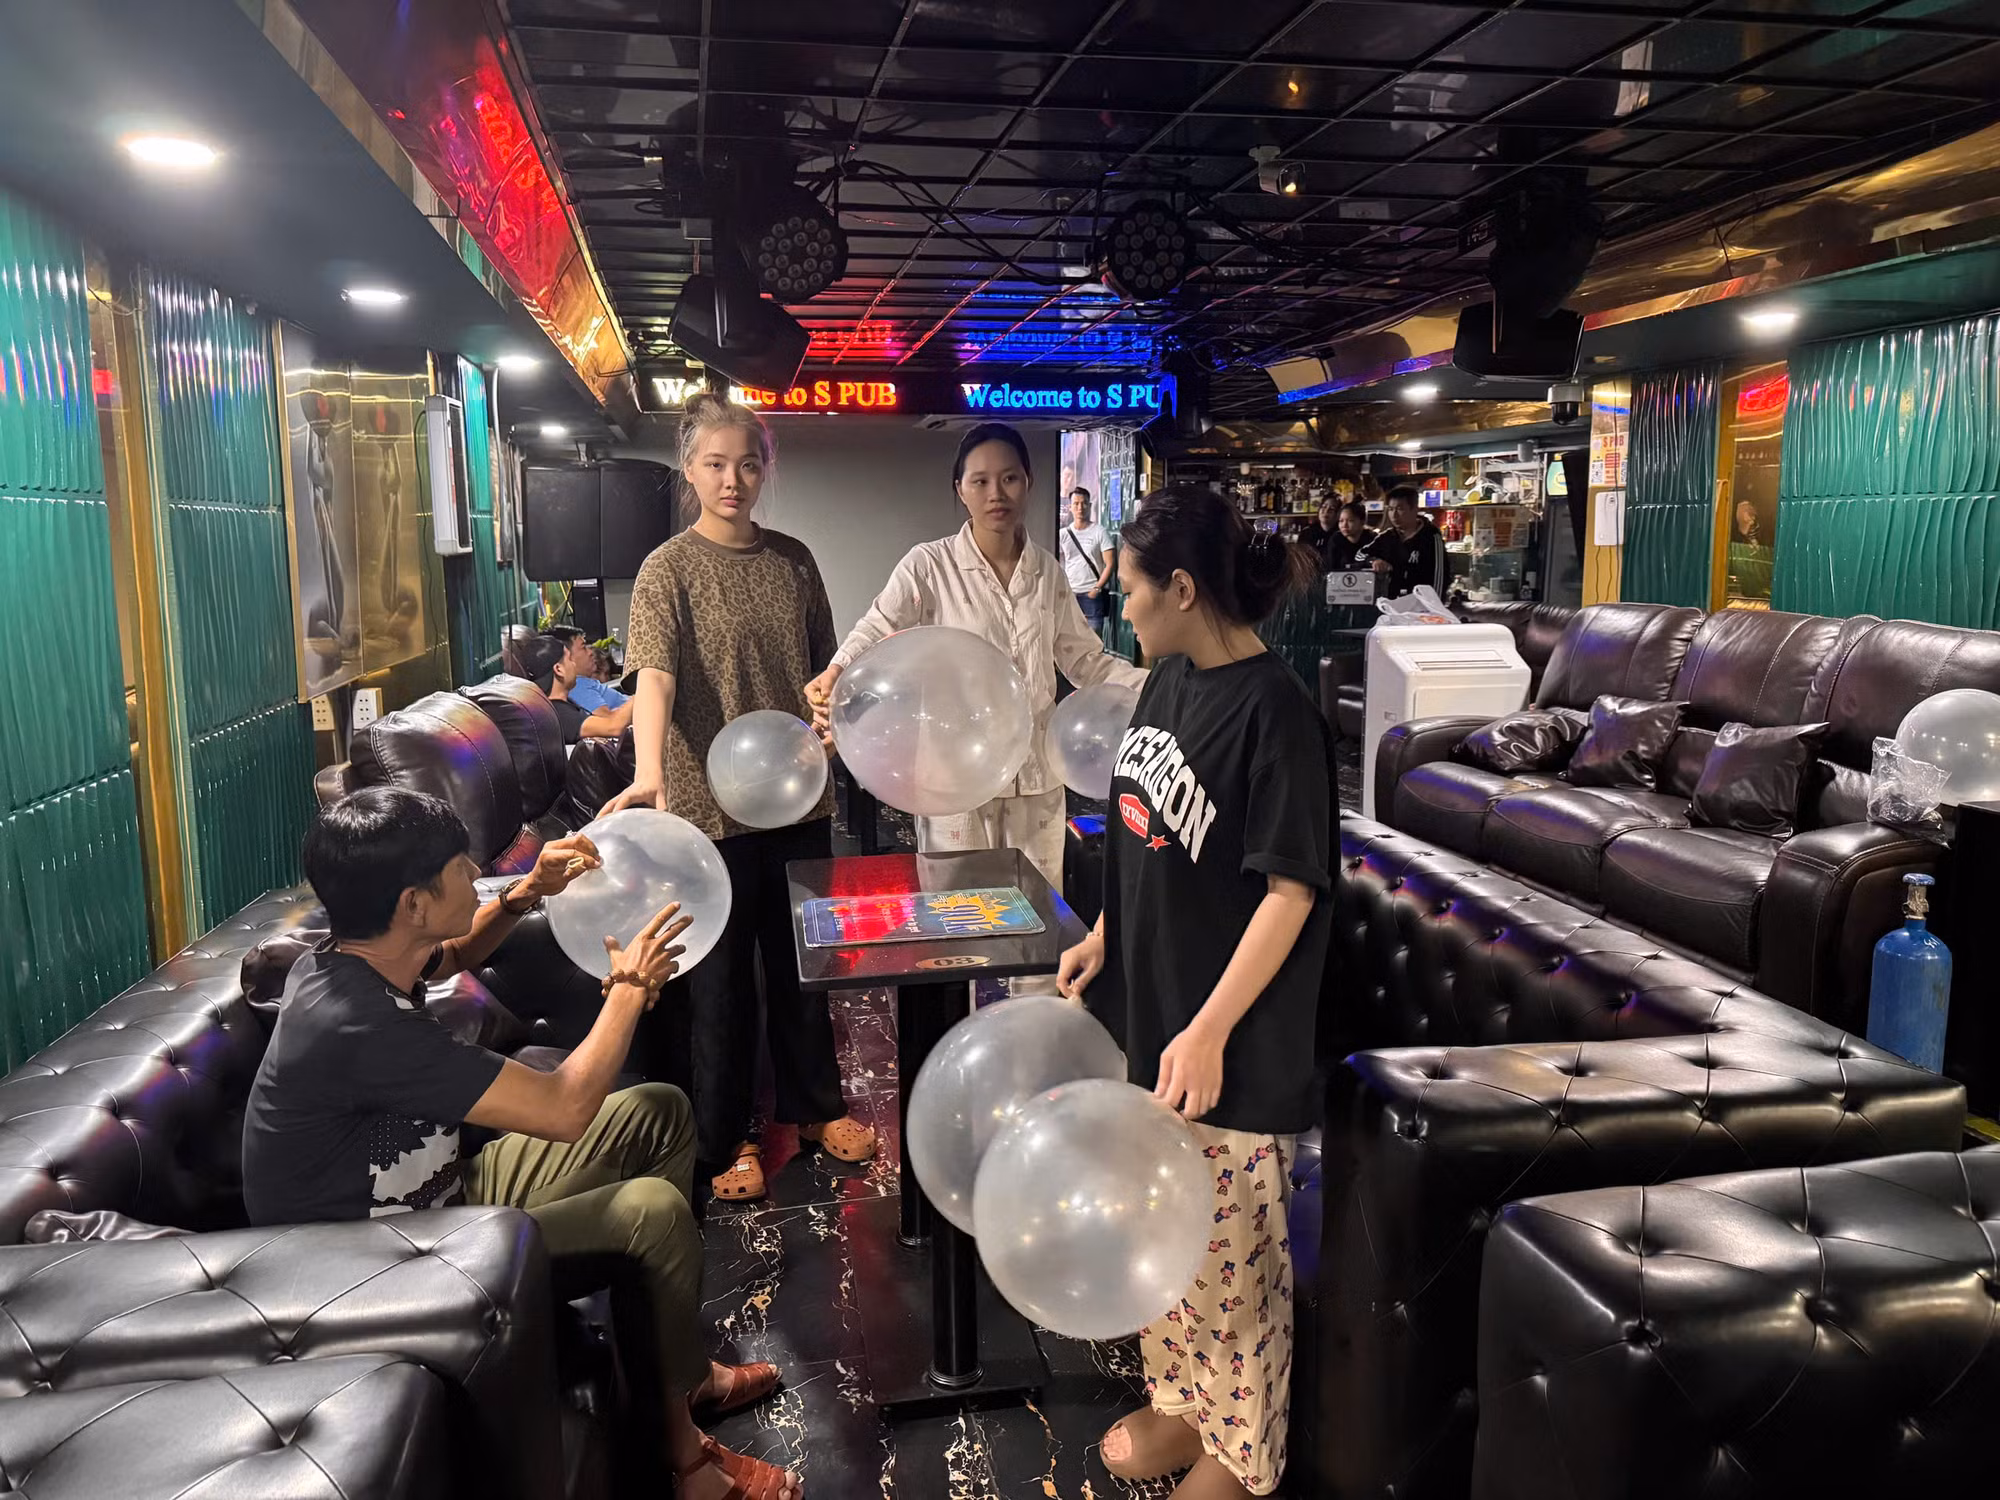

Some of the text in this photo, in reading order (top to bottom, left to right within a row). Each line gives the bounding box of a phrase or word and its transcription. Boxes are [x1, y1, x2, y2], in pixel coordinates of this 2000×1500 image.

[814, 380, 832, 406] S
[837, 382, 897, 407] PUB
[961, 383, 1162, 409] Welcome to S PU
